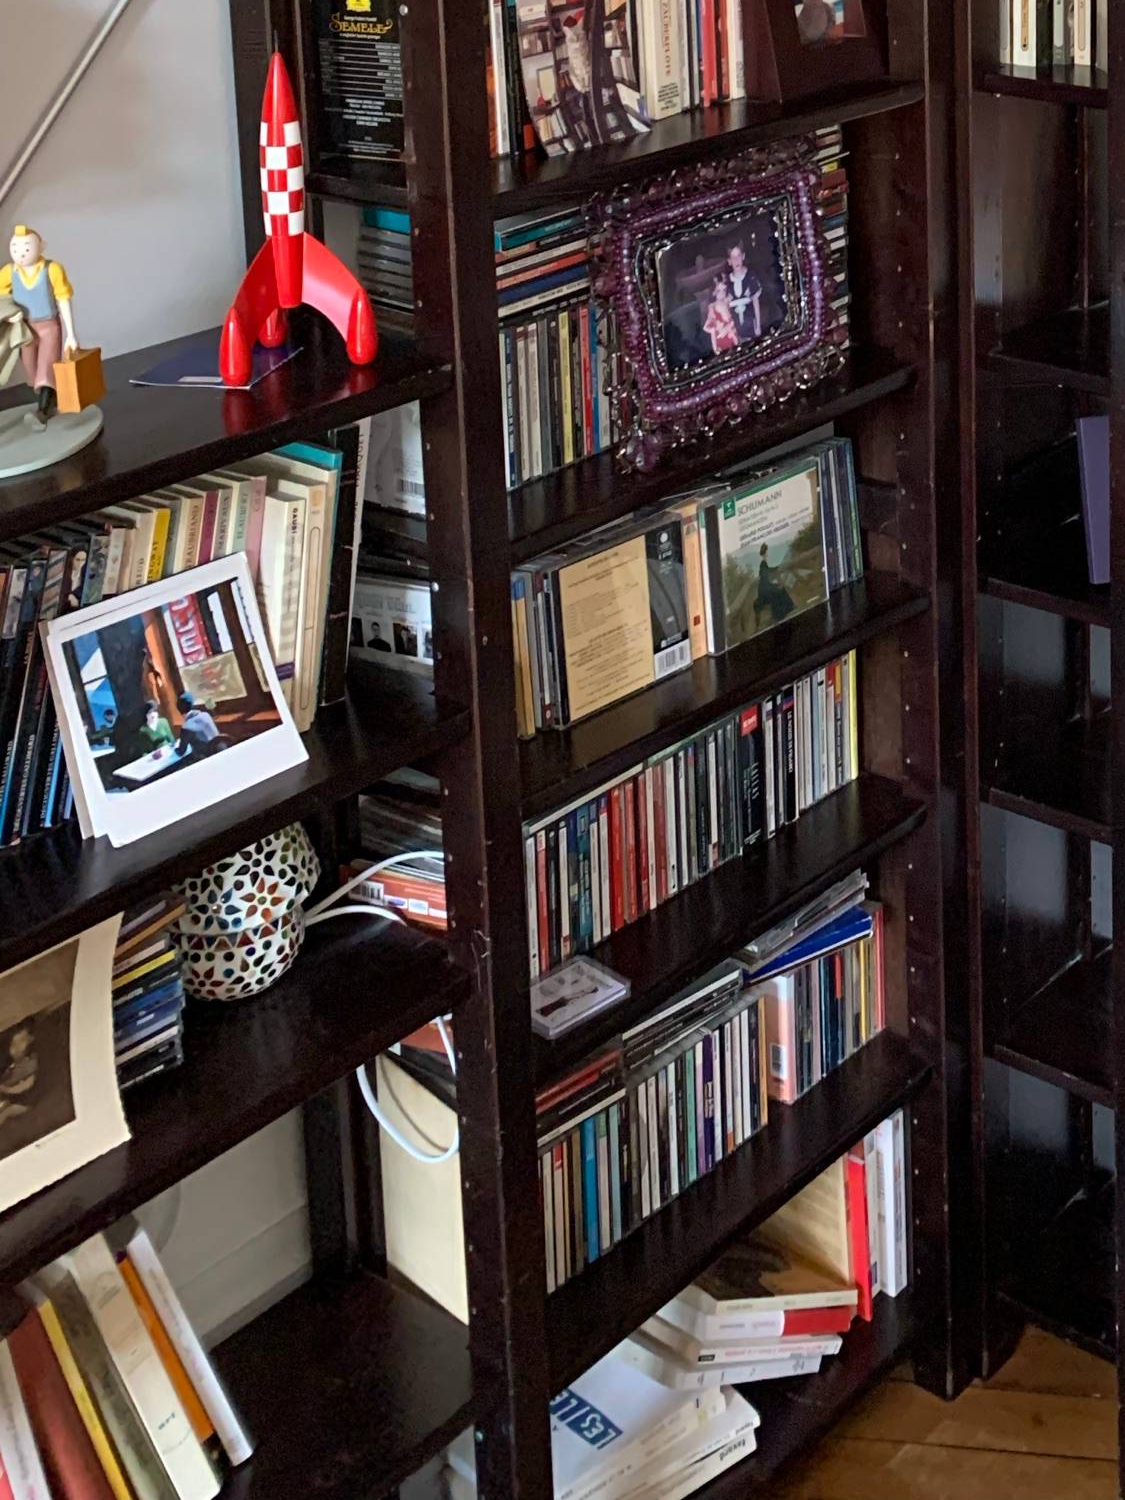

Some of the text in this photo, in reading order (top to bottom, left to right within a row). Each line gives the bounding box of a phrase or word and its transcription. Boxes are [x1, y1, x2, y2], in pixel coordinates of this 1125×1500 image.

[329, 12, 393, 34] SEMELE
[234, 492, 250, 540] FLAUBERT
[737, 490, 783, 517] SCHUMANN
[215, 493, 231, 550] MARIVAUX
[132, 557, 146, 585] REUD
